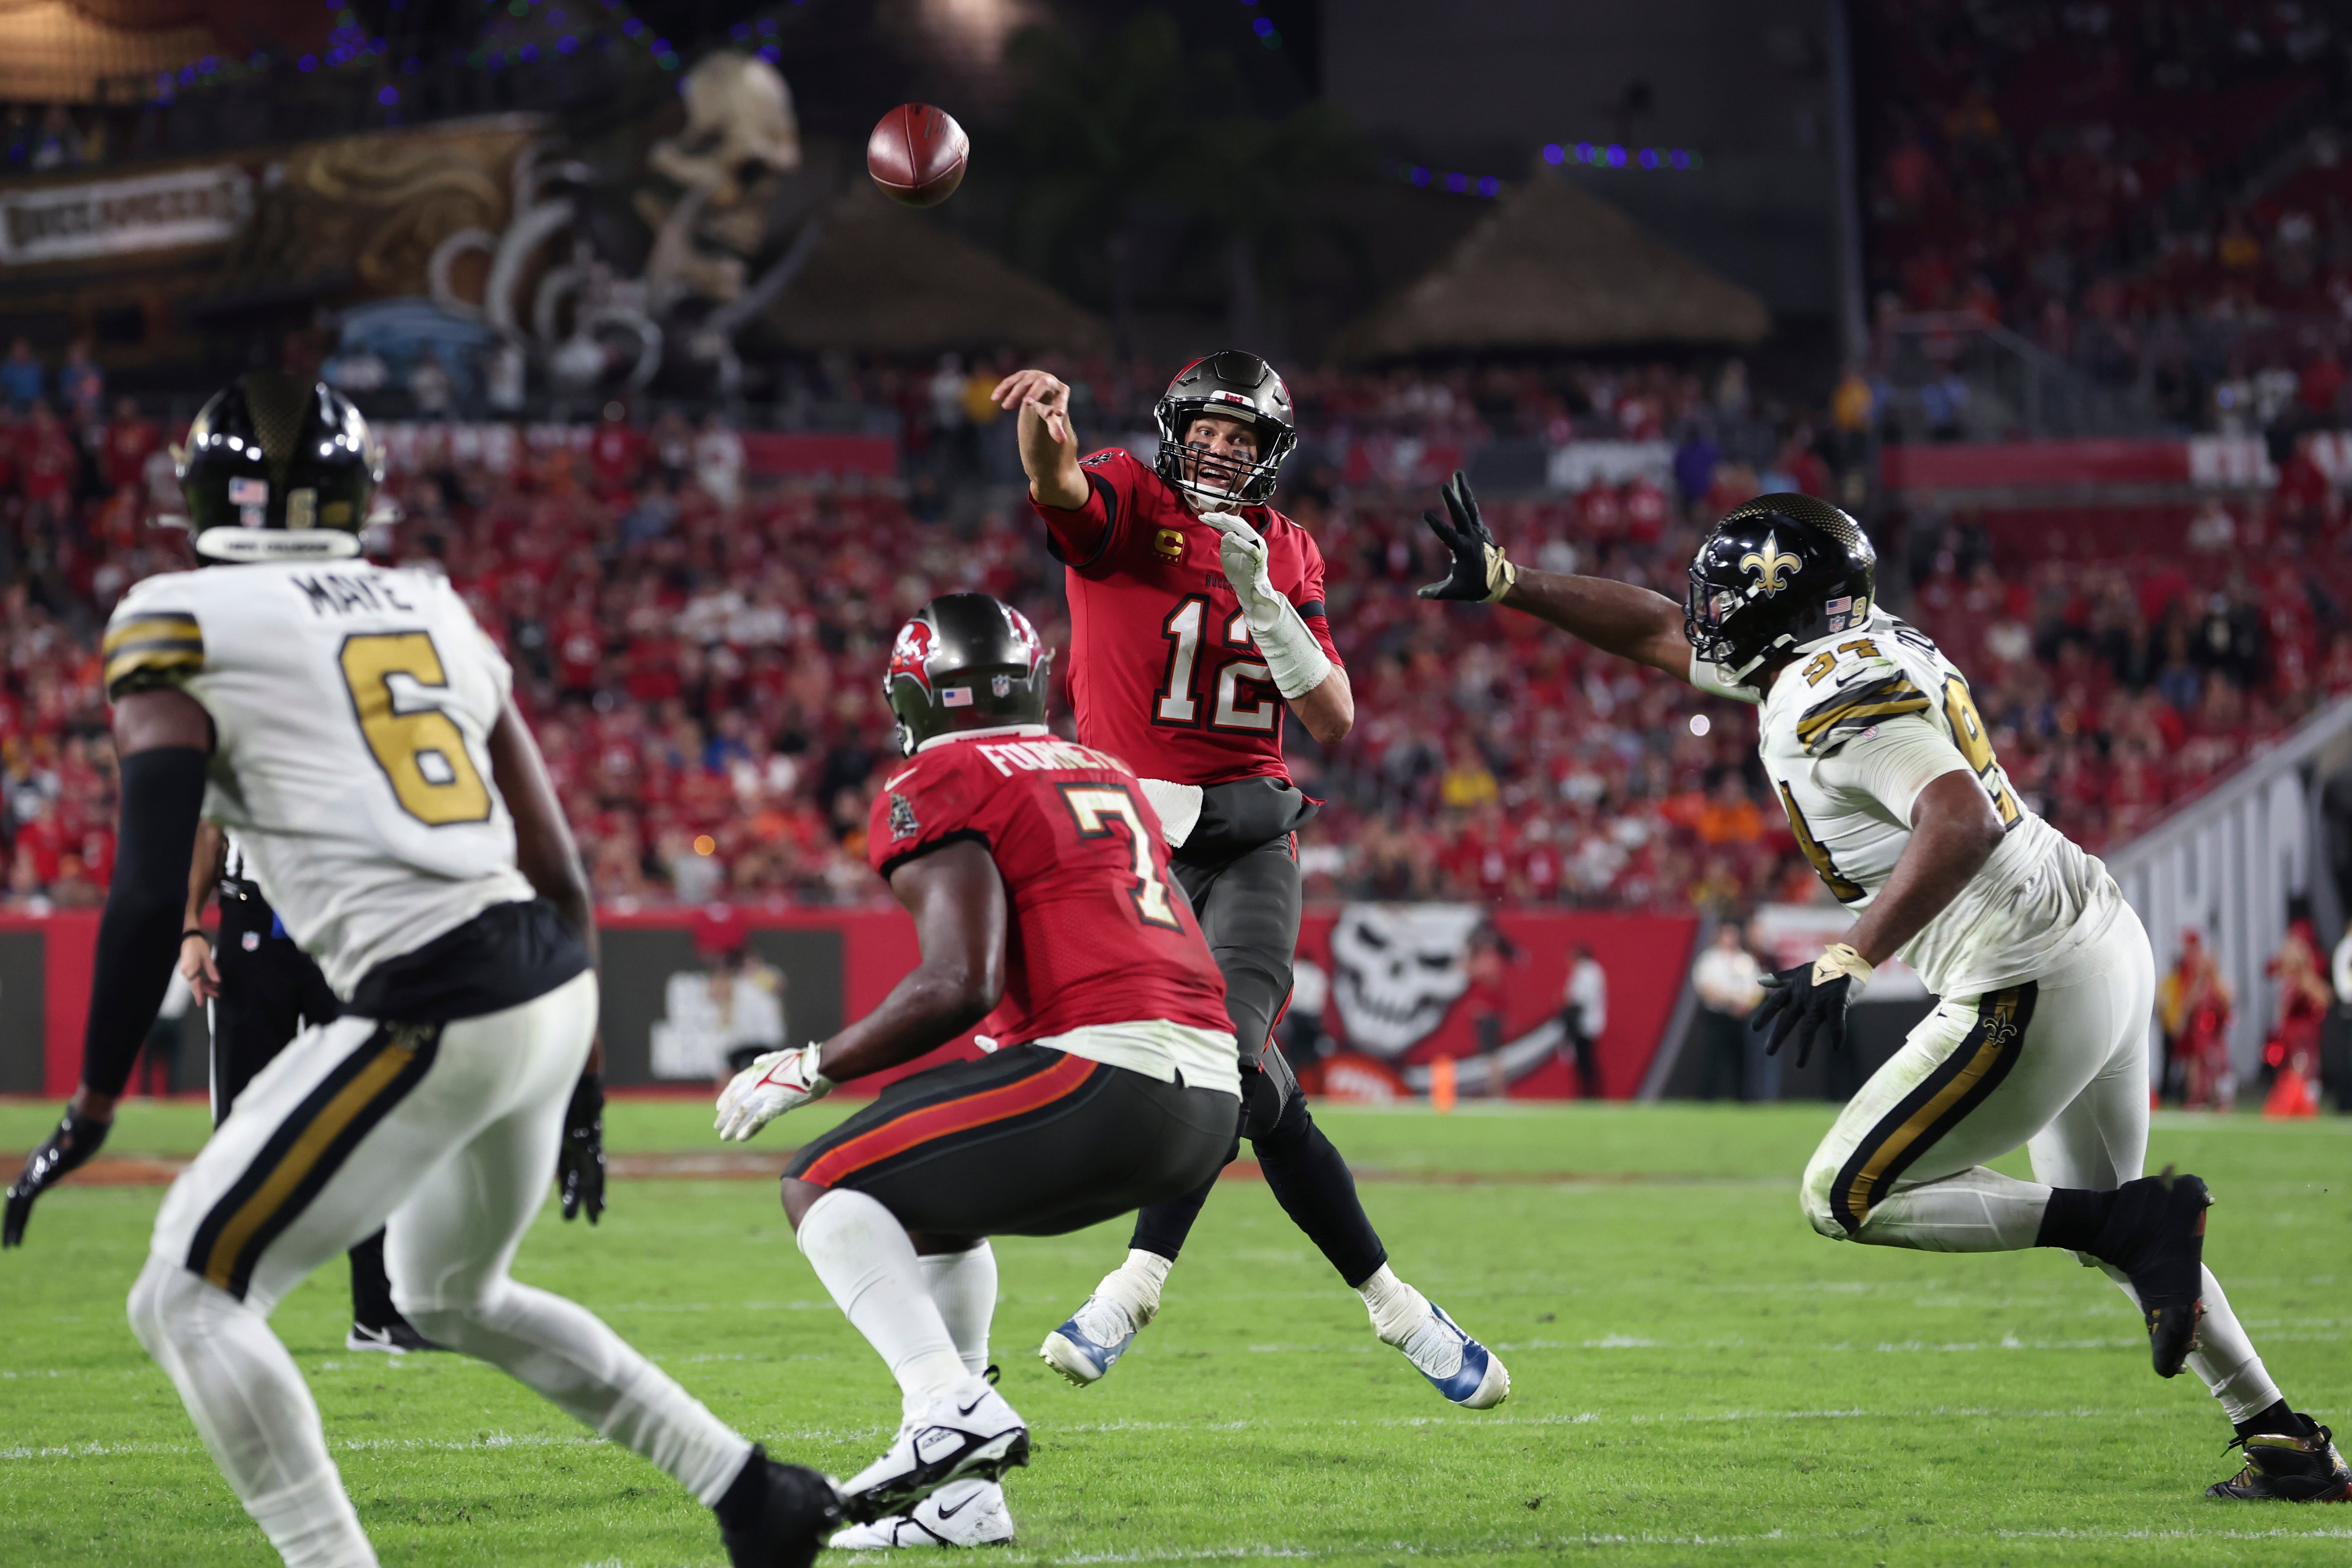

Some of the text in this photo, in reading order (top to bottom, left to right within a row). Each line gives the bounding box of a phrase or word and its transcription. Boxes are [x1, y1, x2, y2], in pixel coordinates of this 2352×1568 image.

[287, 487, 318, 529] 6
[1155, 529, 1183, 556] C
[290, 573, 413, 617] MAYE
[1151, 593, 1281, 738] 12
[336, 631, 492, 827] 6
[1054, 781, 1186, 936] 7
